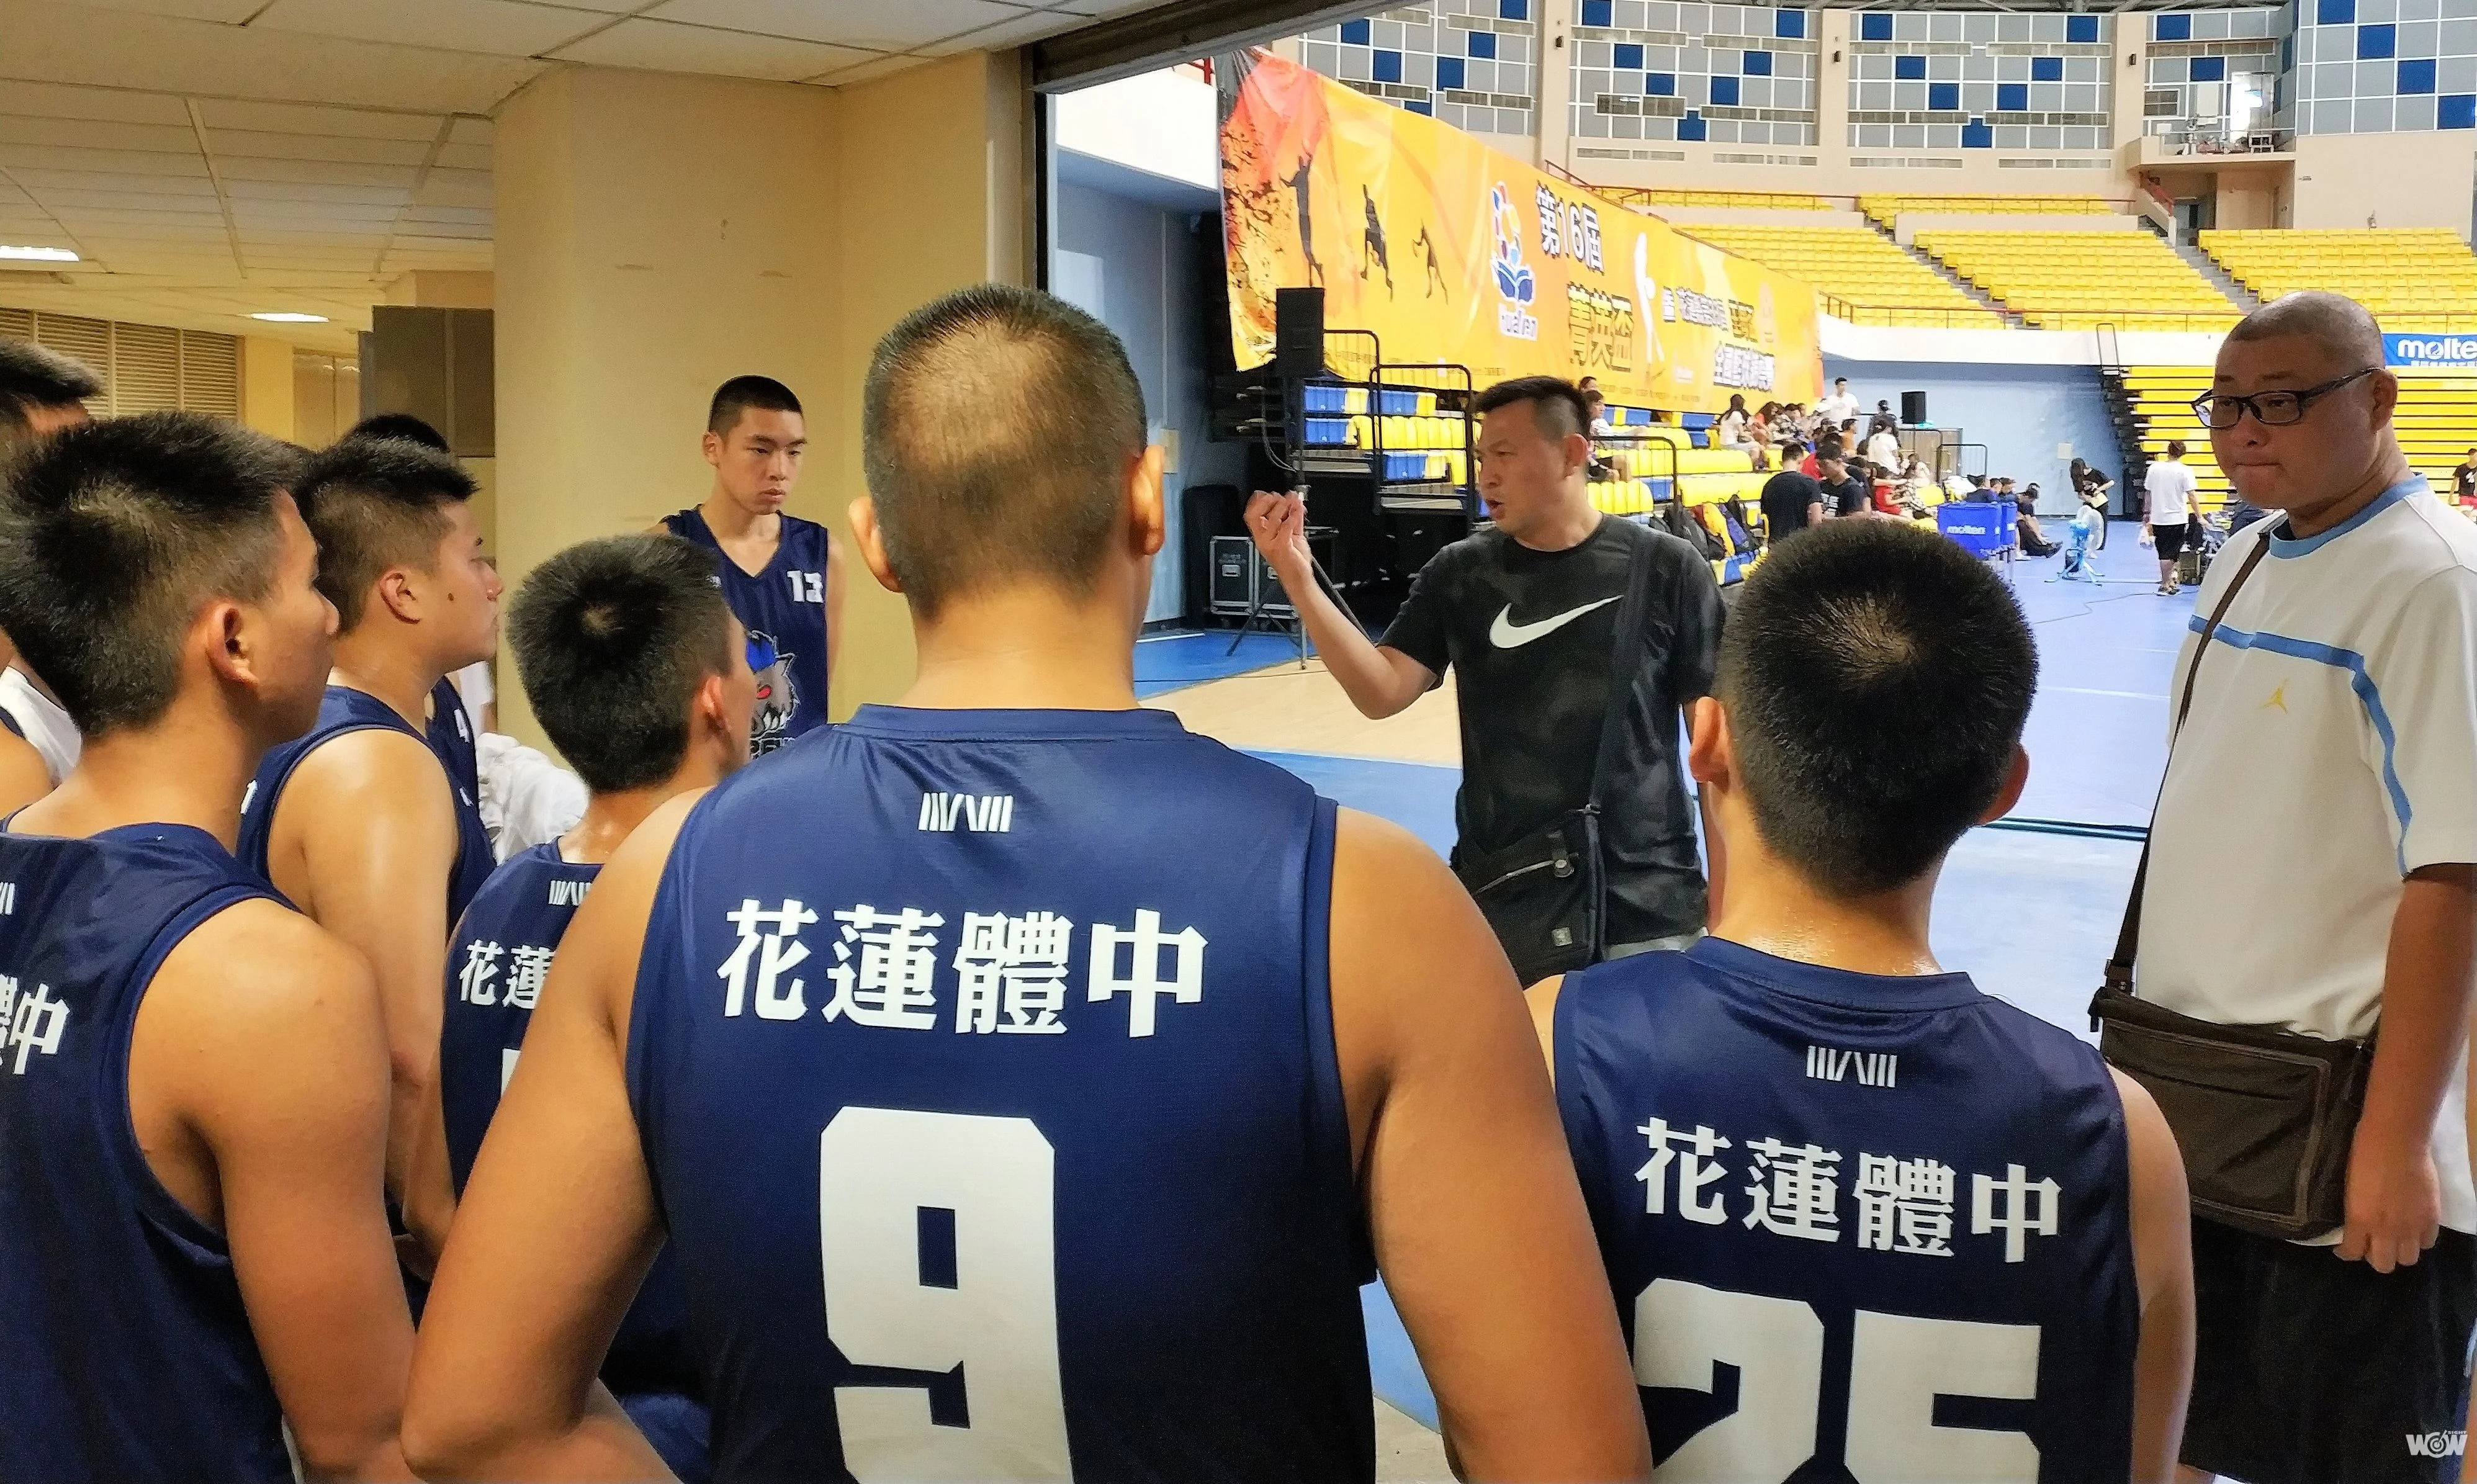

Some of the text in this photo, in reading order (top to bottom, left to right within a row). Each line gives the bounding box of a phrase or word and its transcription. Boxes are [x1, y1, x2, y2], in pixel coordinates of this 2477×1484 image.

[1535, 180, 1605, 275] 第16屆
[1566, 281, 1634, 372] 菁英盃
[717, 898, 1208, 1038] 花蓮體中
[1634, 1117, 2062, 1263] 花蓮體中
[820, 1106, 1074, 1484] 9
[1633, 1277, 2042, 1484] 25
